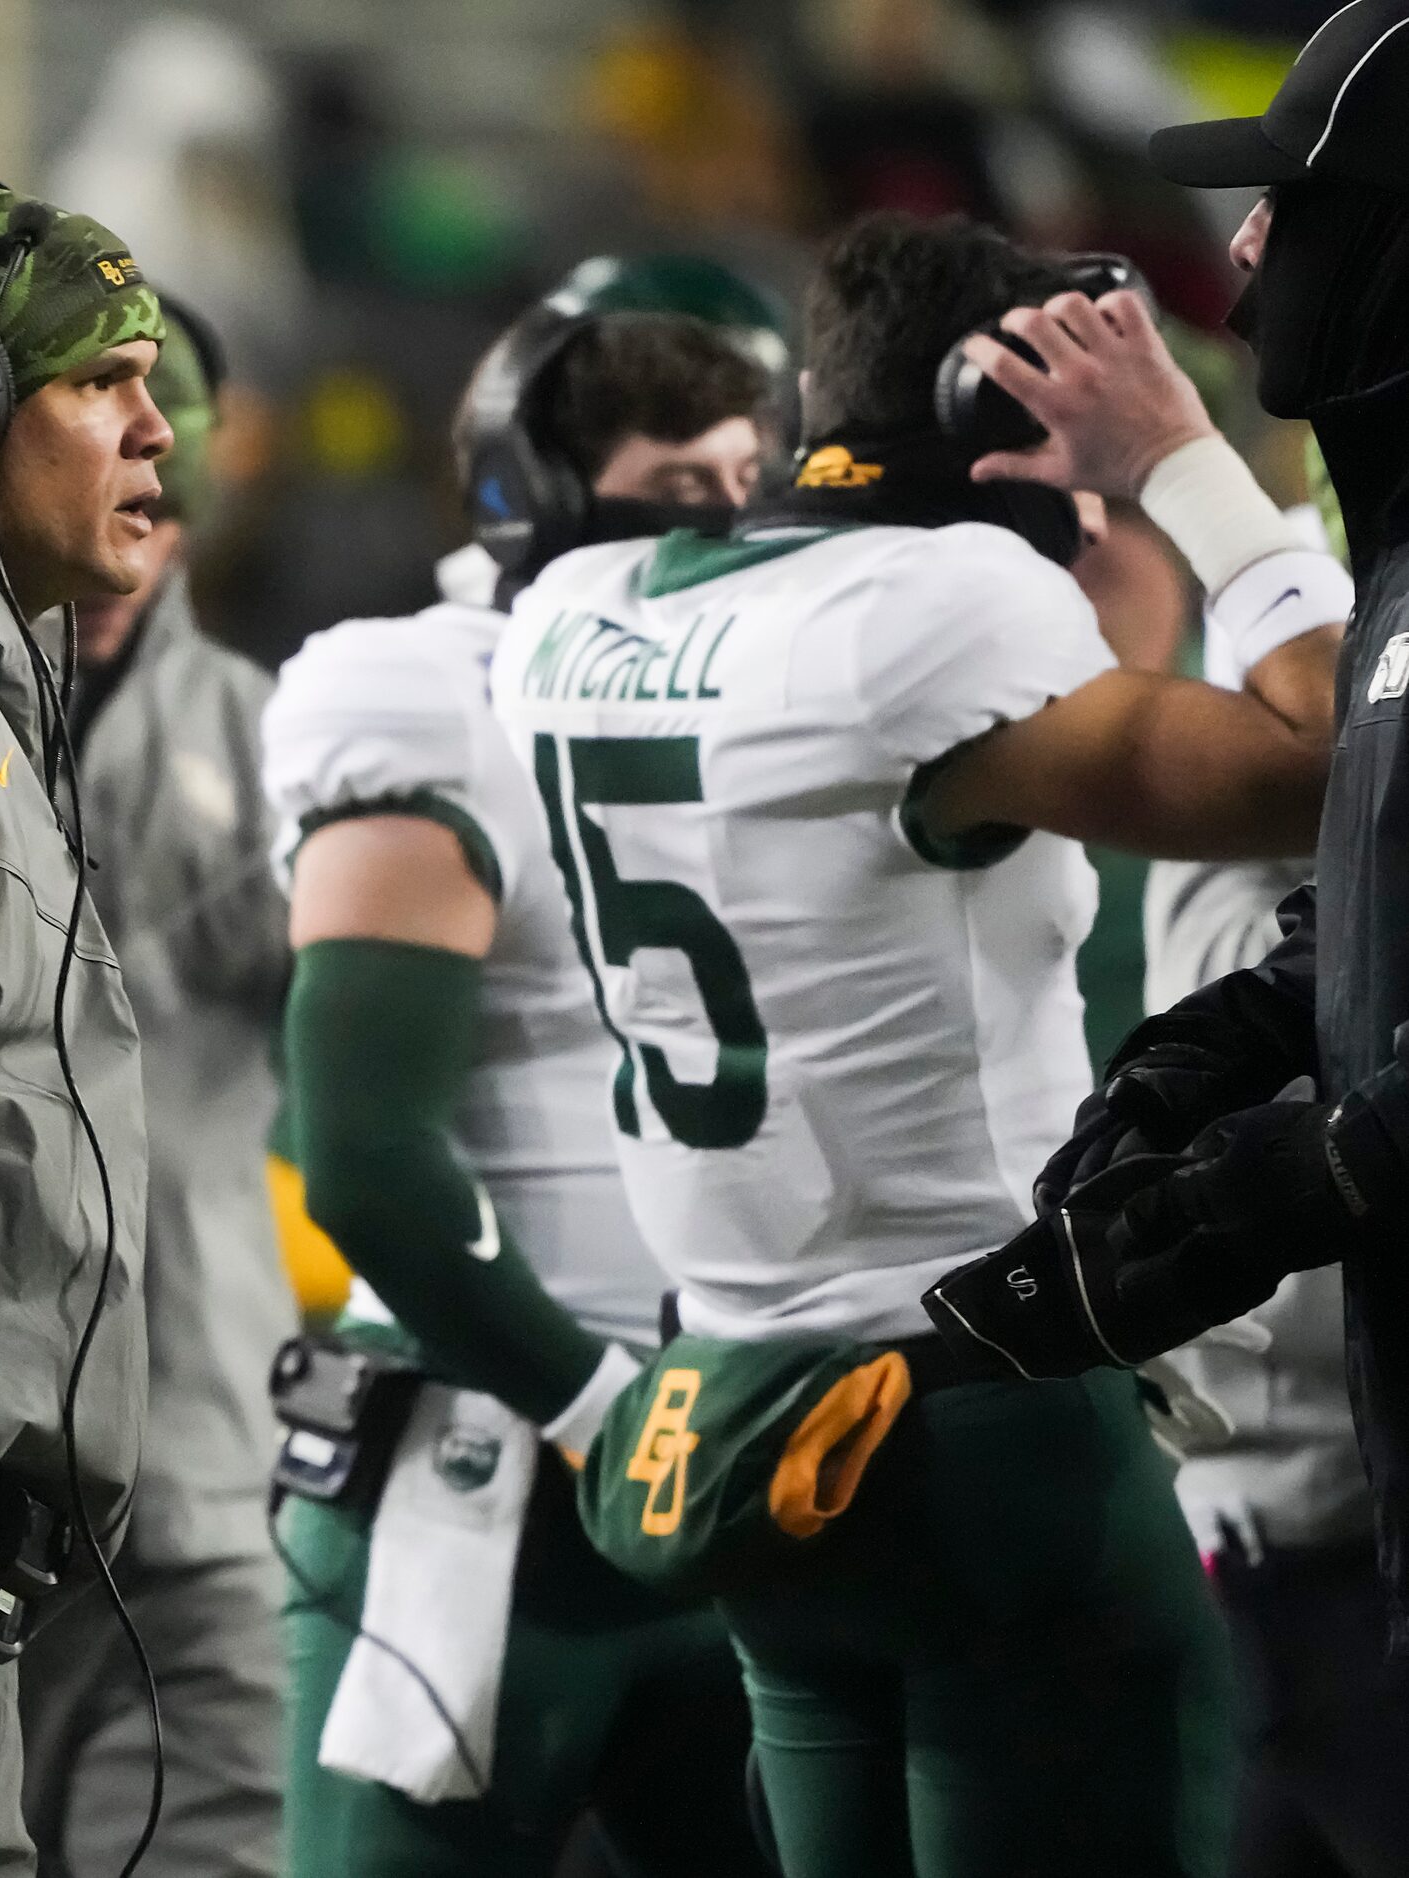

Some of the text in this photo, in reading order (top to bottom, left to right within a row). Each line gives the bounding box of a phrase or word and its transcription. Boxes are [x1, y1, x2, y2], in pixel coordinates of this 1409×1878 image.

[97, 260, 125, 286] BU
[534, 733, 768, 1149] 15
[626, 1368, 701, 1536] BU
